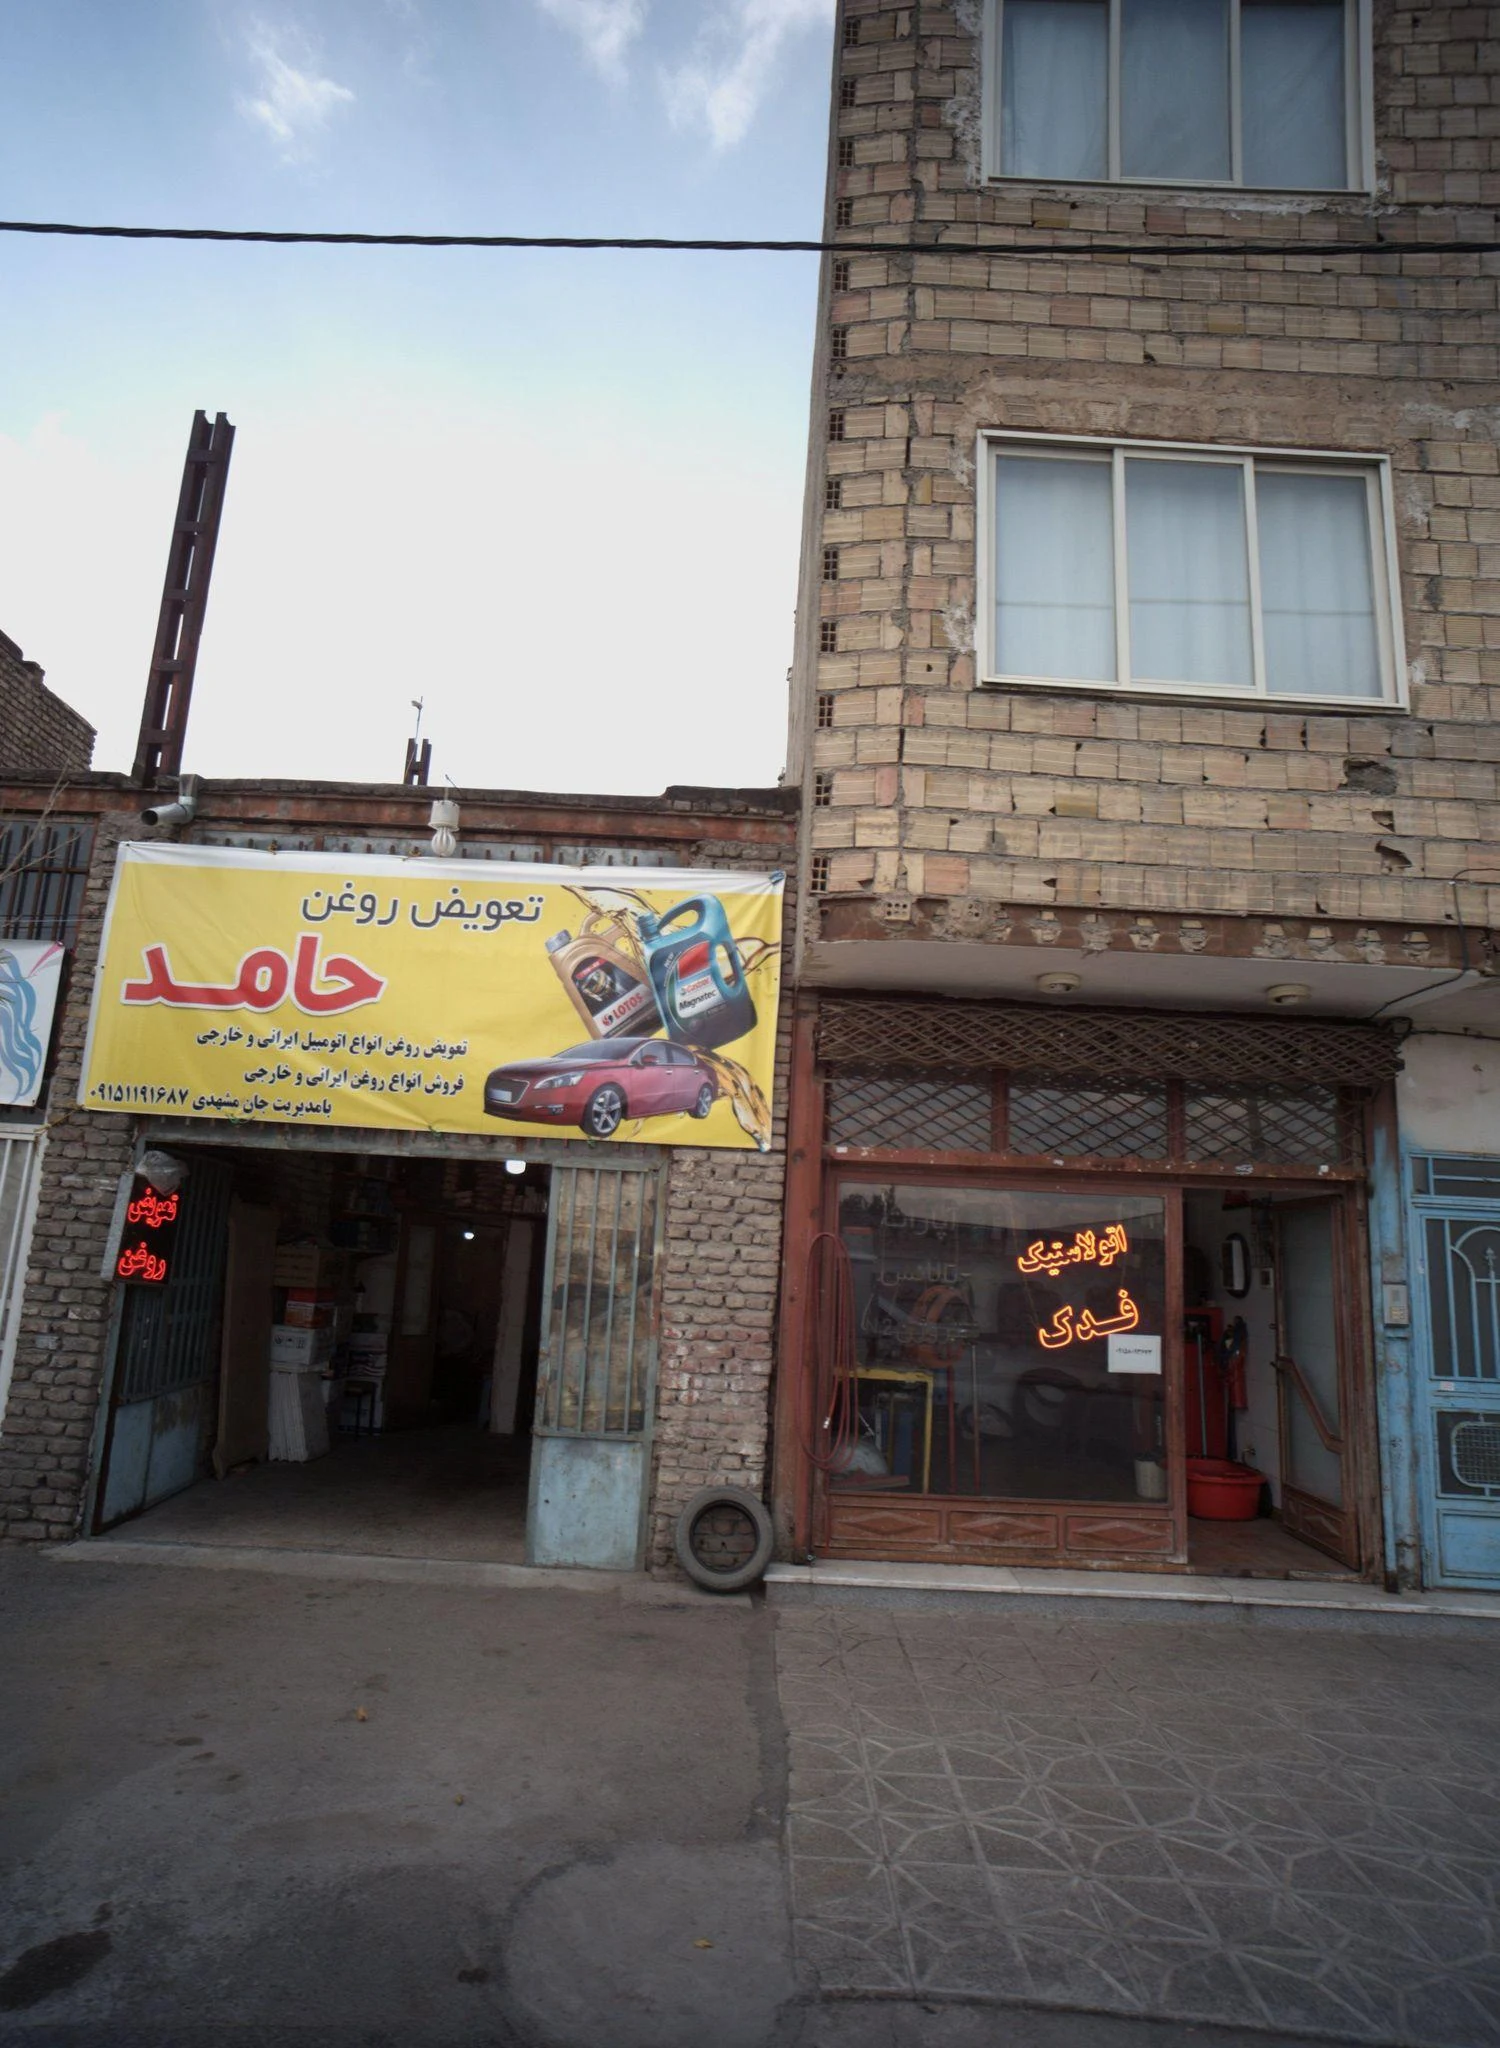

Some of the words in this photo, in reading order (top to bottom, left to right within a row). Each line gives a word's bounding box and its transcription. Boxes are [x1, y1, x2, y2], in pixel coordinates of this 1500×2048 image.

[301, 881, 399, 926] روغن
[410, 887, 545, 932] تعویض
[122, 933, 386, 1014] حامد
[612, 992, 644, 1020] LOTOS
[679, 989, 717, 1010] Magnatec
[196, 1026, 243, 1047] خارجی
[247, 1033, 255, 1048] و
[257, 1030, 299, 1049] ایرانی
[300, 1031, 346, 1052] اتومبیل
[350, 1035, 383, 1056] انواع
[385, 1040, 420, 1058] روغن
[423, 1039, 468, 1061] تعویض
[243, 1063, 292, 1083] خارجی
[294, 1071, 303, 1086] و
[305, 1068, 348, 1088] ایرانی
[349, 1071, 385, 1091] روغن
[388, 1072, 422, 1093] انواع
[89, 1082, 190, 1105] ۰۹۱۵۱۱۹۱۶۸۷
[424, 1076, 465, 1097] فروش
[192, 1091, 240, 1111] مشهدی
[242, 1094, 269, 1115] جان
[128, 1186, 179, 1228] تعویض
[117, 1240, 167, 1281] روغن
[1038, 1288, 1140, 1349] فدک
